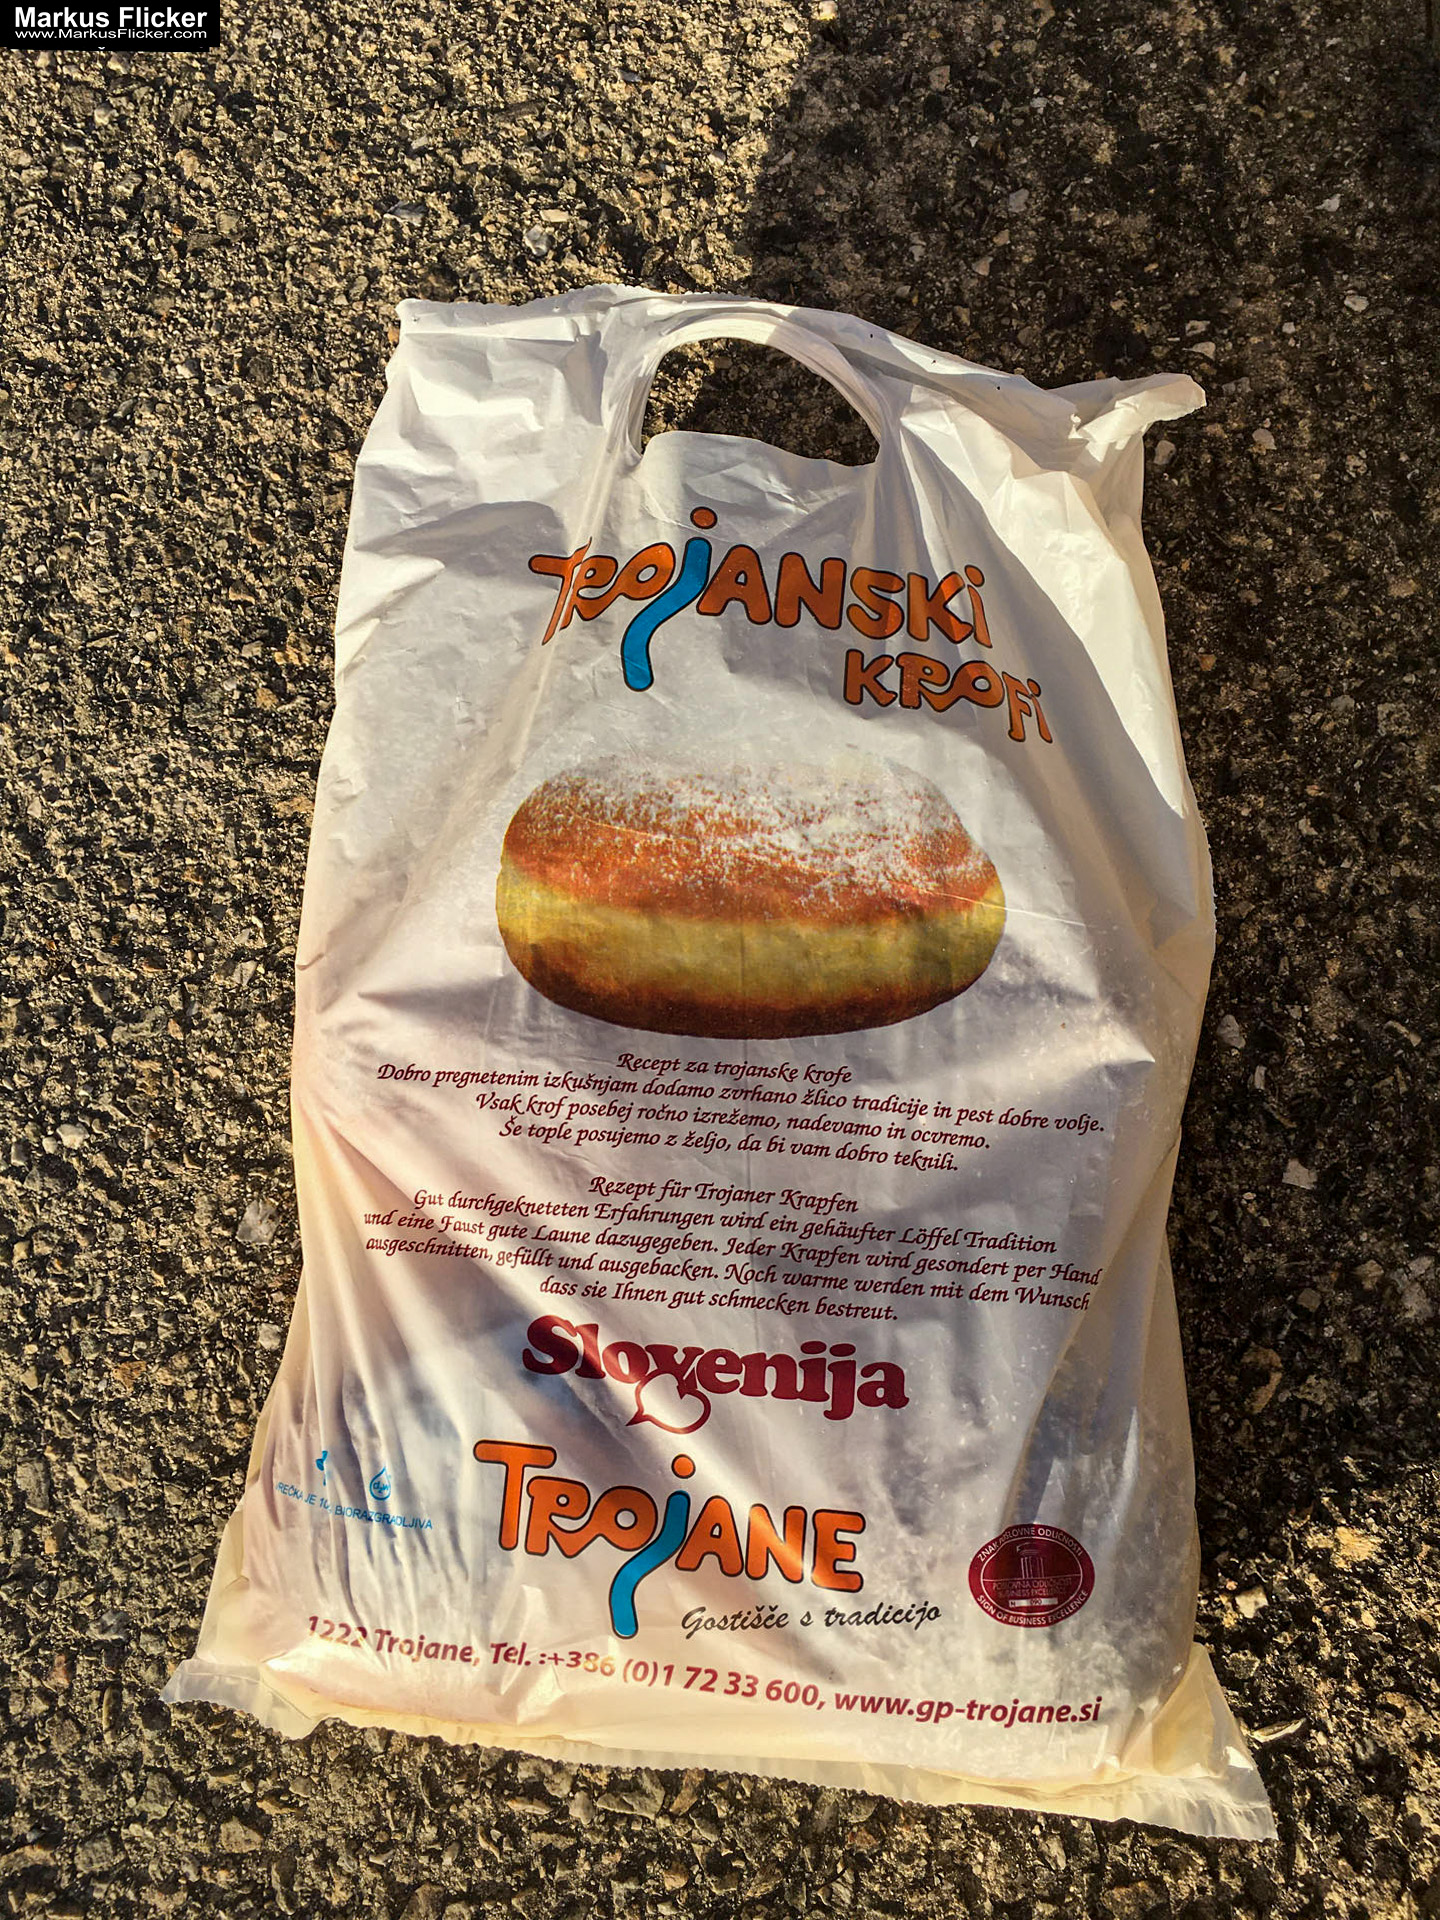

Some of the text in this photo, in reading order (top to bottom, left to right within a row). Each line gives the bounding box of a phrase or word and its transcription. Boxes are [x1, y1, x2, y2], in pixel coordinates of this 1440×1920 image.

[617, 1052, 852, 1084] Recept za trojanske krofe
[377, 1063, 1105, 1136] Dobro pregnetenim izkušnjam dodamo zvrhano žlico tradicije in pest dobre volje.
[476, 1093, 991, 1149] Vsak krof posebej ročno izrežemo, nadevamo in ocvremo.
[499, 1116, 959, 1171] Še tople posujemo z željo, da bi vam dobro teknili.
[414, 1189, 1057, 1253] Gut durchgekneteten Erfahrungen wird ein gehäufter Löffel Tradition
[588, 1175, 858, 1215] Rezept für Trojaner Krapfen
[364, 1210, 1103, 1286] und eine Faust gute Laune dazugegeben. Jeder Krapfen wird gesondert per Hand
[366, 1236, 1090, 1310] ausgeschnitten, gefüllt und ausgebacken. Noch warme werden mit dem Wunsch
[540, 1275, 898, 1320] dass sie Ihnen gut schmecken bestreut.
[522, 1315, 910, 1421] Slovenija
[304, 1493, 317, 1505] JE
[978, 1542, 999, 1562] ZNAK
[681, 1601, 942, 1639] Gostišče s tradicijo
[977, 1595, 995, 1615] SIGN
[996, 1611, 1008, 1621] OF
[1008, 1615, 1047, 1625] BUSINESS
[1048, 1590, 1088, 1623] EXCELLENCE
[307, 1615, 368, 1648] 1222
[374, 1628, 481, 1667] Trojane,
[490, 1642, 531, 1666] Tel.
[683, 1666, 719, 1693] 72
[724, 1671, 758, 1698] 33
[765, 1678, 825, 1711] 600,
[834, 1691, 1103, 1729] www.gp-trojane.si
